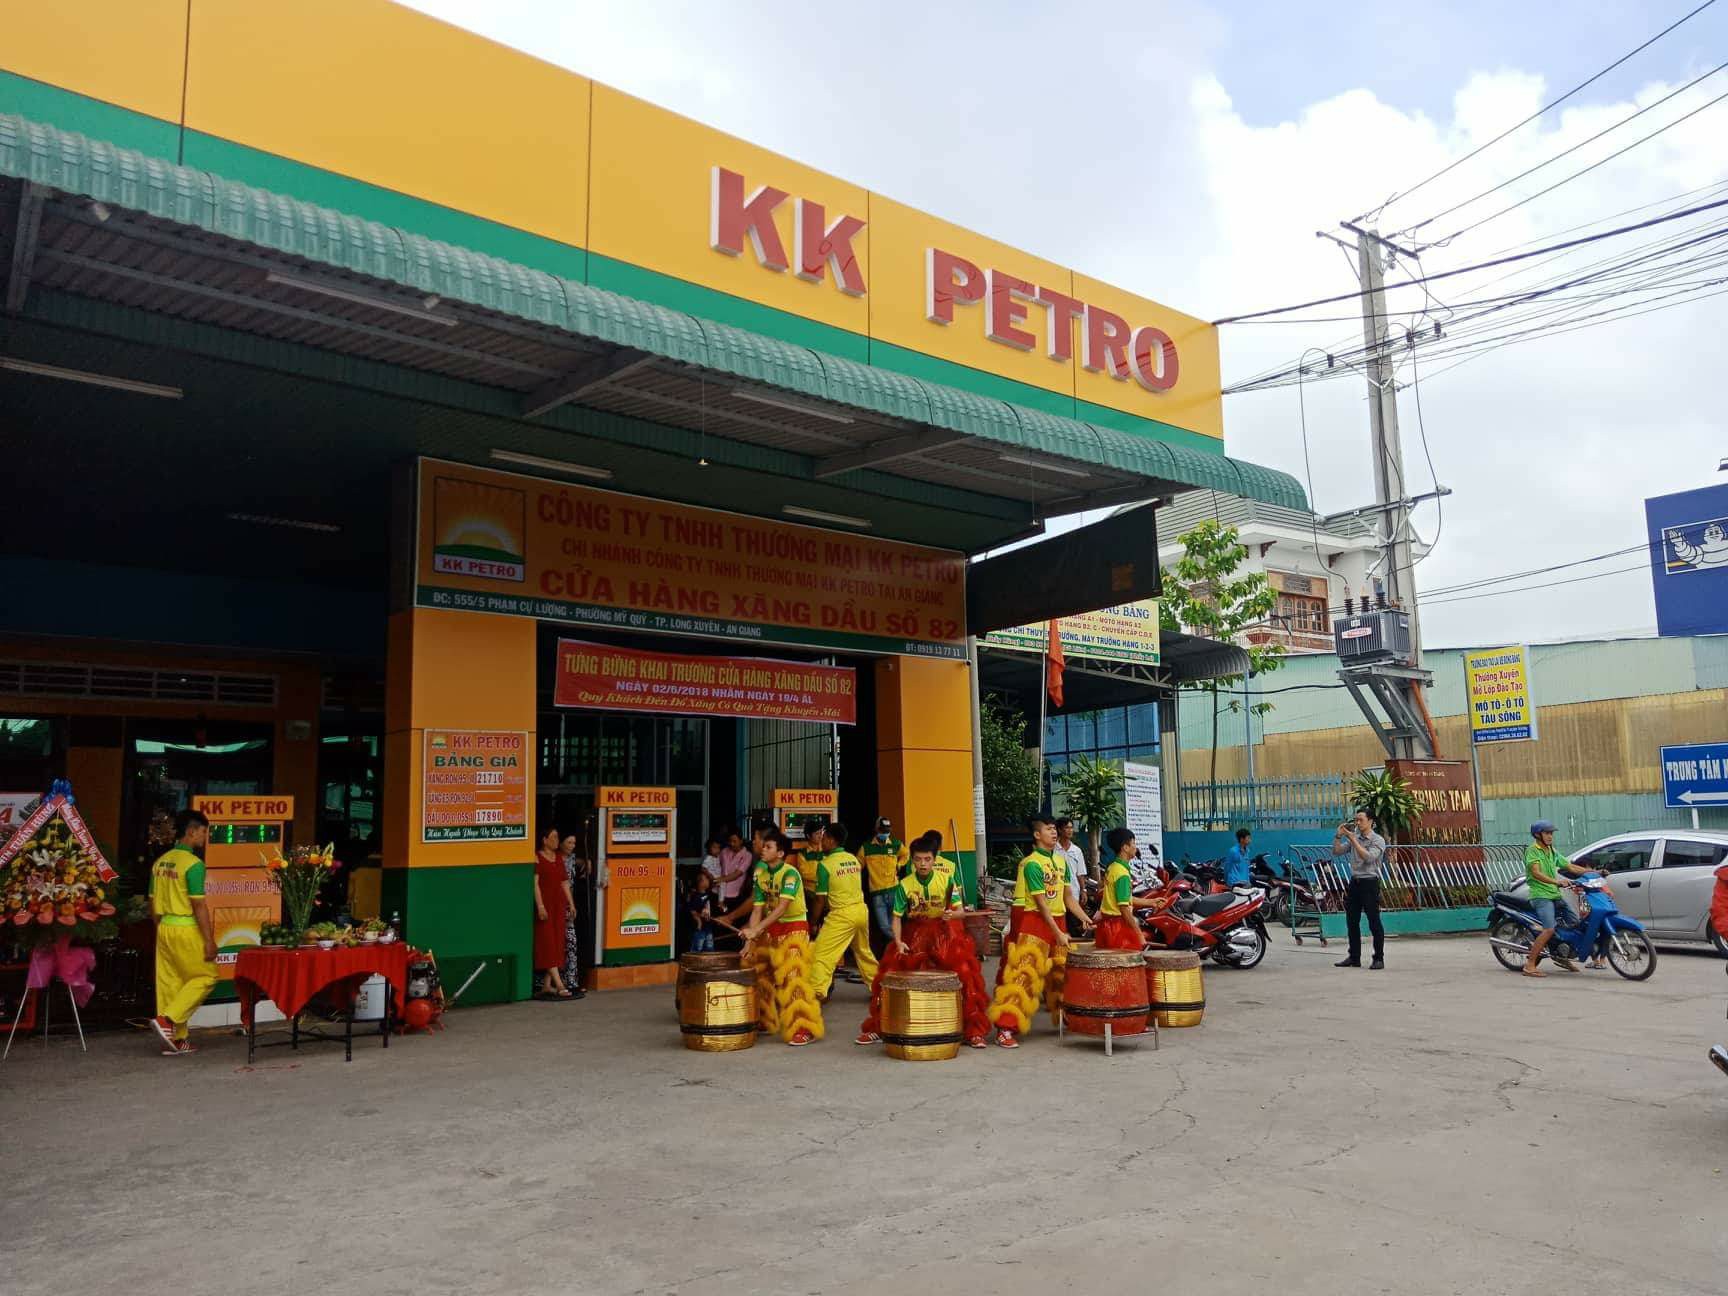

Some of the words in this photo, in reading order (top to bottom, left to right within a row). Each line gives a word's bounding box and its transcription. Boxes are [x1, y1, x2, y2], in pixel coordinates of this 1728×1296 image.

[710, 165, 867, 298] KK
[926, 247, 1179, 394] PETRO
[537, 489, 610, 532] CÔNG
[622, 508, 650, 537] TY
[658, 513, 723, 550] TNHH
[731, 527, 816, 563] THƯƠNG
[825, 542, 860, 573] MẠI
[868, 551, 893, 575] KK
[901, 554, 958, 584] PETRO
[442, 557, 462, 571] KK
[469, 560, 515, 577] PETRO
[562, 537, 587, 558] CHI
[592, 541, 641, 565] NHÁNH
[646, 547, 682, 572] CÔNG
[686, 555, 703, 573] TY
[708, 559, 741, 581] TNHH
[822, 576, 835, 592] KK
[840, 578, 875, 598] PETRO
[899, 587, 911, 602] AN
[914, 589, 944, 606] GIANG
[541, 564, 614, 603] CỬA
[629, 577, 720, 614] HÀNG
[732, 591, 810, 625] XĂNG
[821, 598, 876, 632] DẦU
[886, 608, 919, 637] SỐ
[928, 618, 958, 640] 82
[432, 592, 452, 605] ĐC:
[454, 593, 486, 608] 555/5
[655, 616, 668, 628] TP.
[670, 618, 692, 631] LONG
[694, 619, 720, 633] XUYÊN
[726, 623, 737, 634] AN
[738, 625, 761, 637] GIANG
[602, 653, 636, 678] BỪNG
[640, 659, 668, 680] KHAI
[672, 662, 716, 685] TRƯƠNG
[719, 661, 740, 687] CỬA
[743, 665, 772, 688] HÀNG
[774, 668, 801, 691] XĂNG
[803, 670, 823, 693] DẦU
[825, 672, 839, 694] SỐ
[840, 677, 852, 695] 82
[616, 680, 649, 693] NGÀY
[652, 684, 709, 697] 02/6/2018
[1475, 699, 1489, 712] MÔ
[1491, 699, 1501, 710] TÔ
[1506, 698, 1512, 708] Ô
[1514, 696, 1524, 707] TÔ
[1498, 710, 1522, 723] SÔNG
[453, 735, 472, 749] KK
[477, 736, 521, 749] PETRO
[434, 751, 484, 767] BẢNG
[490, 752, 518, 767] GIÁ
[1666, 760, 1698, 781] TRUNG
[1699, 754, 1722, 780] TÂM
[477, 773, 504, 784] 21710
[607, 791, 624, 803] KK
[630, 791, 669, 803] PETRO
[780, 793, 795, 804] KK
[799, 793, 832, 804] PETRO
[200, 801, 224, 815] KK
[231, 800, 288, 815] PETRO
[476, 811, 502, 822] 17890
[617, 866, 634, 877] RON
[638, 865, 649, 877] 95
[635, 925, 657, 933] PETRO
